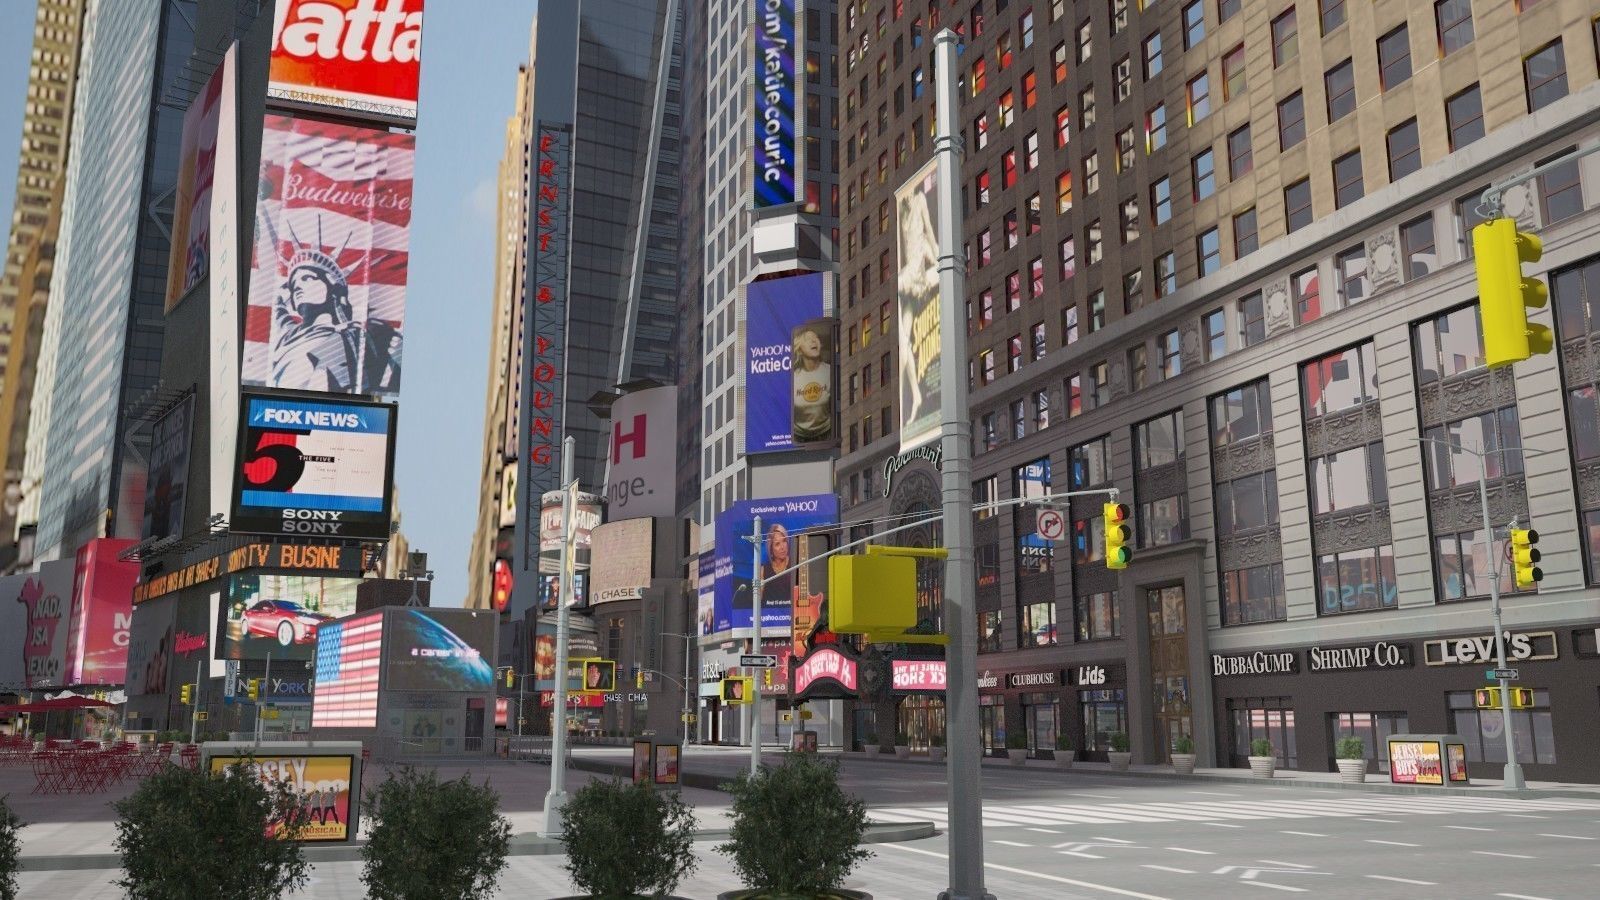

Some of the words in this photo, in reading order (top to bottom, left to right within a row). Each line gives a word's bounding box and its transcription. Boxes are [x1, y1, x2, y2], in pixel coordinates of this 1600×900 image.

[538, 135, 558, 252] ERNST
[750, 344, 784, 358] YAHOO!
[751, 357, 781, 374] Katie
[531, 335, 555, 465] YOUNG
[264, 408, 303, 425] FOX
[305, 411, 359, 429] NEWS
[883, 444, 942, 497] Paramount
[282, 508, 343, 521] SONY
[785, 500, 818, 514] YAHOO!
[282, 520, 342, 534] SONY
[248, 543, 270, 567] TV
[280, 545, 341, 569] BUSINE
[601, 587, 635, 599] CHASE
[411, 648, 418, 656] a
[1440, 630, 1531, 662] Lev's
[1311, 646, 1371, 671] SHRIMP
[702, 660, 720, 679] at&t
[1079, 665, 1105, 685] Lids
[272, 678, 305, 693] YORK
[1012, 672, 1055, 687] CLUBHOUSE
[603, 693, 622, 702] CHASE
[1393, 742, 1422, 760] JERSEY
[1395, 760, 1418, 775] BOYS
